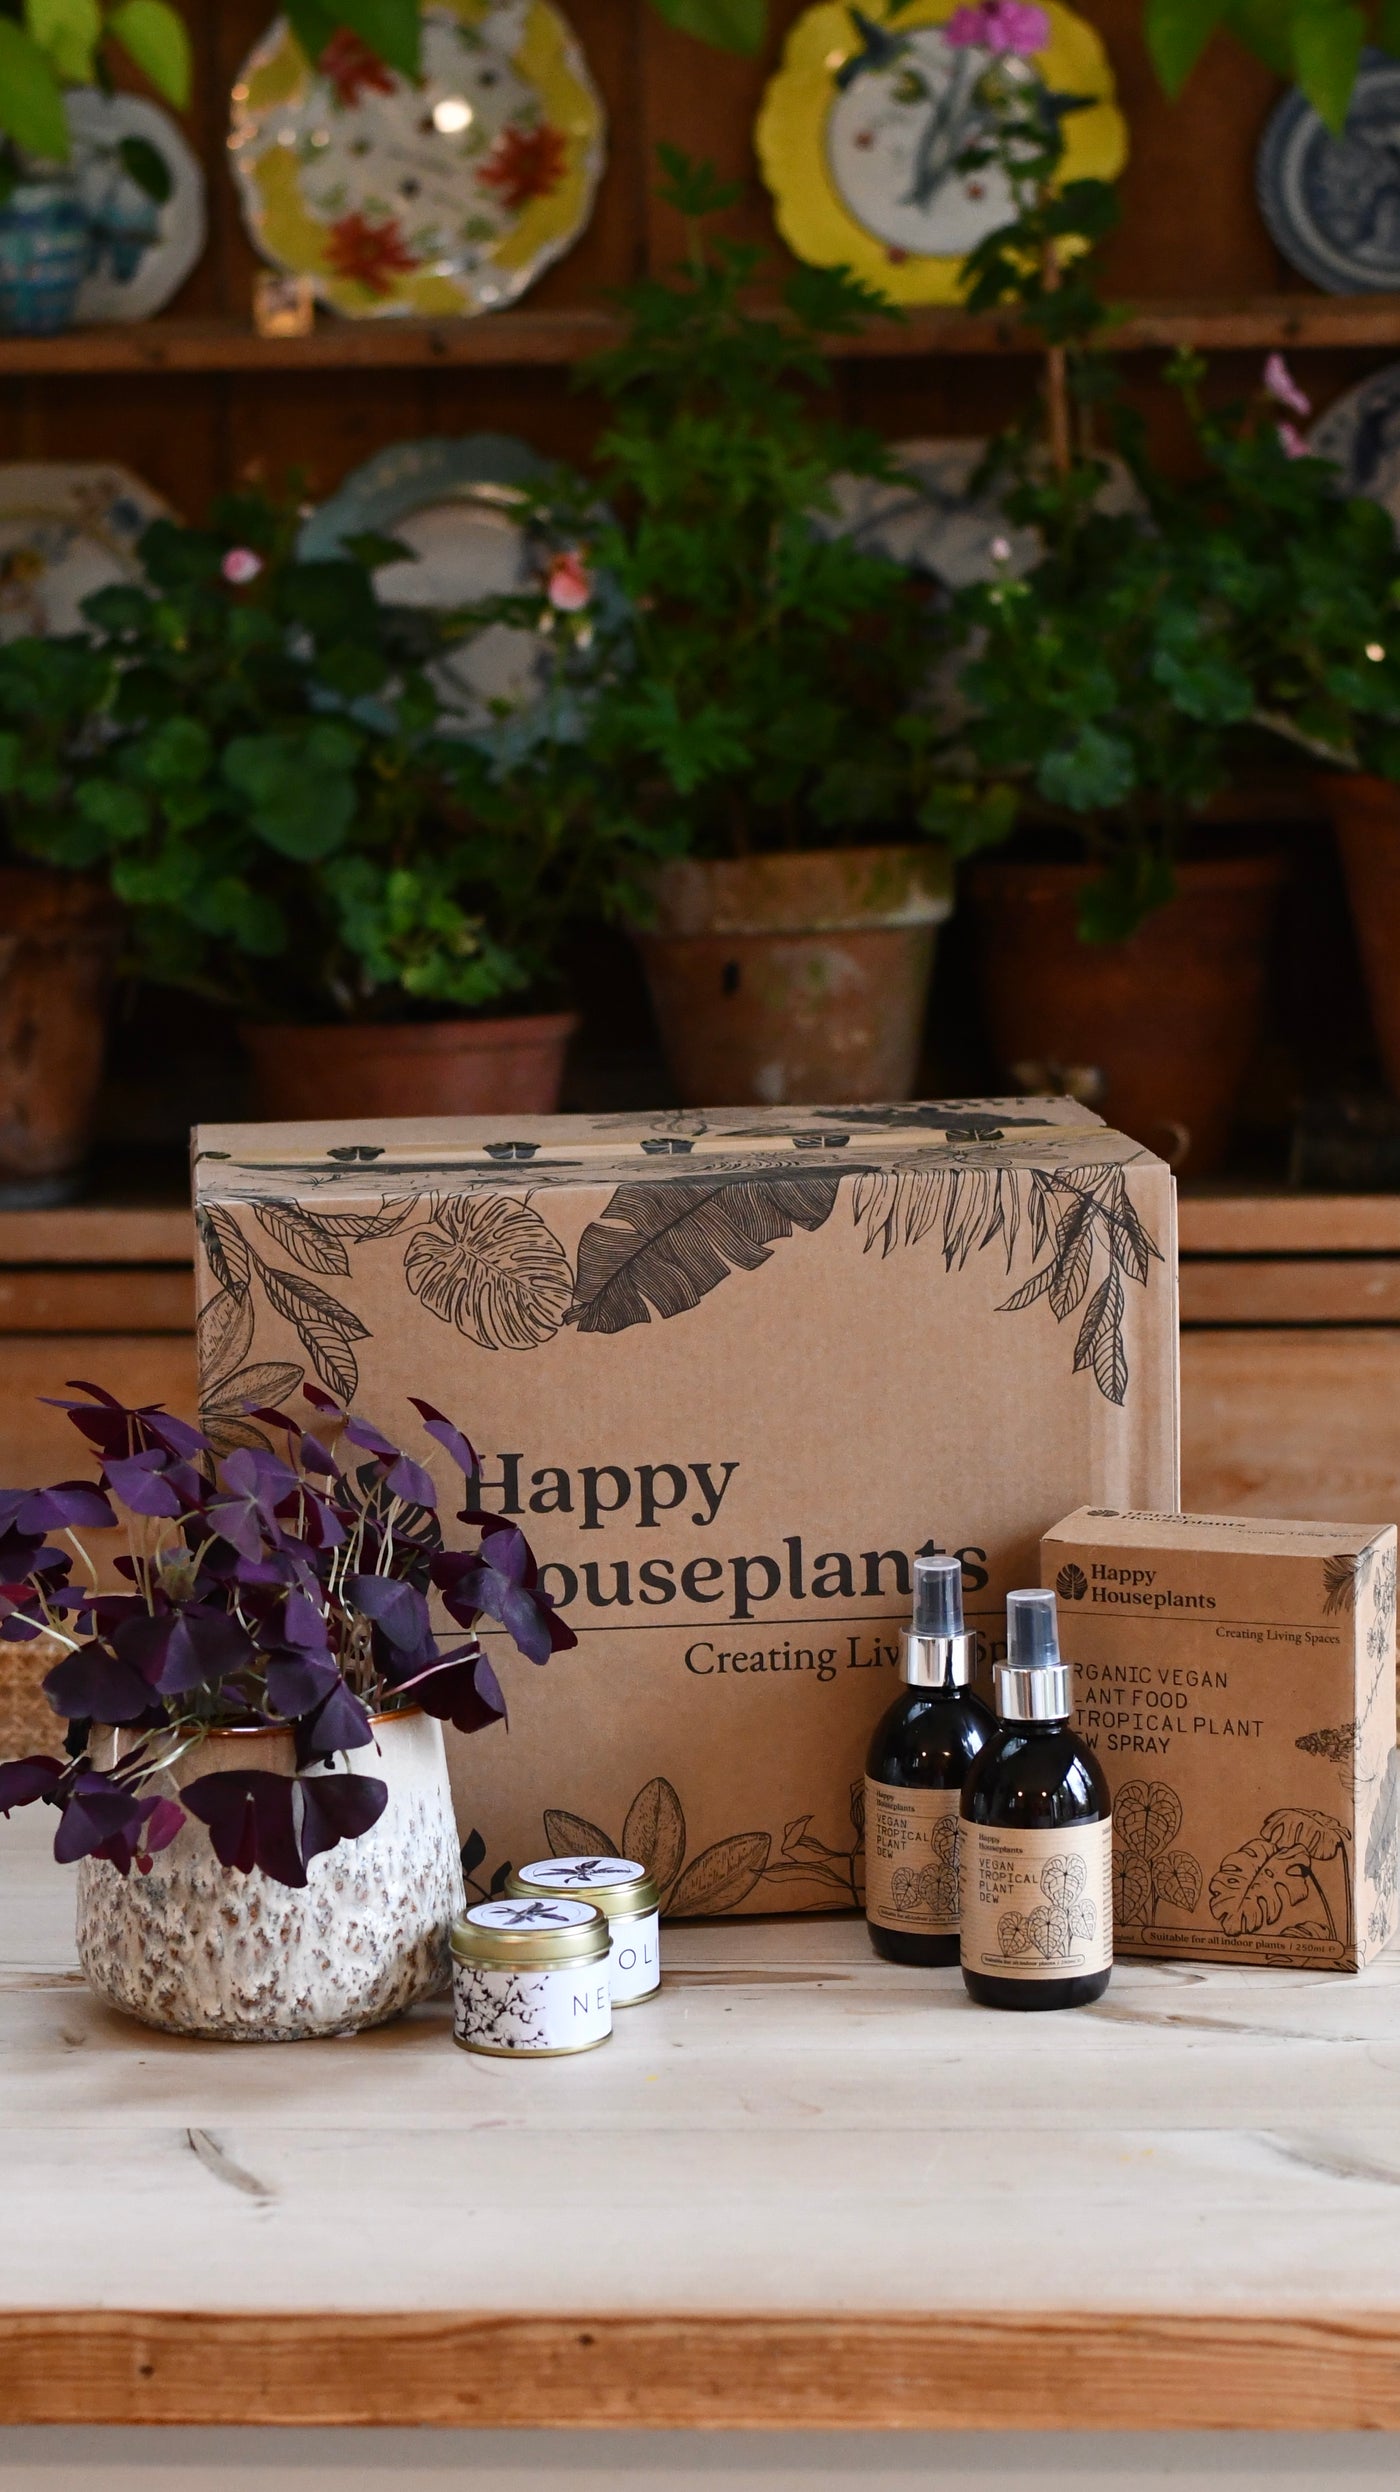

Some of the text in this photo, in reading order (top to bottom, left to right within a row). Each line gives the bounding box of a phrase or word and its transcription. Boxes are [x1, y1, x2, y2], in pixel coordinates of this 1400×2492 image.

[463, 1453, 740, 1530] Happy
[537, 1536, 989, 1619] ouseplans
[1091, 1564, 1157, 1586] Happy
[1091, 1587, 1217, 1610] Houseplants
[1215, 1626, 1341, 1645] Creating Living Spaces
[684, 1641, 837, 1682] Creating
[847, 1637, 899, 1668] Liv
[1073, 1663, 1228, 1688] RGANIC VEGAN
[1075, 1687, 1188, 1709] ANT FOOD
[1075, 1709, 1265, 1738] TROPICAL PLANT
[1107, 1734, 1170, 1754] SPRAY
[877, 1813, 907, 1828] VEGAN
[877, 1824, 930, 1842] TROPICAL
[877, 1835, 907, 1850] PLANT
[877, 1846, 894, 1859] DEW
[979, 1858, 1014, 1871] VEGAN
[979, 1868, 1039, 1884] TROPICAL
[979, 1880, 1014, 1894] PLANT
[980, 1892, 1000, 1904] DEW
[1150, 1932, 1190, 1943] Suitable
[1191, 1933, 1206, 1944] for
[1207, 1934, 1219, 1945] all
[1221, 1935, 1253, 1947] indoor
[1255, 1938, 1286, 1951] plants
